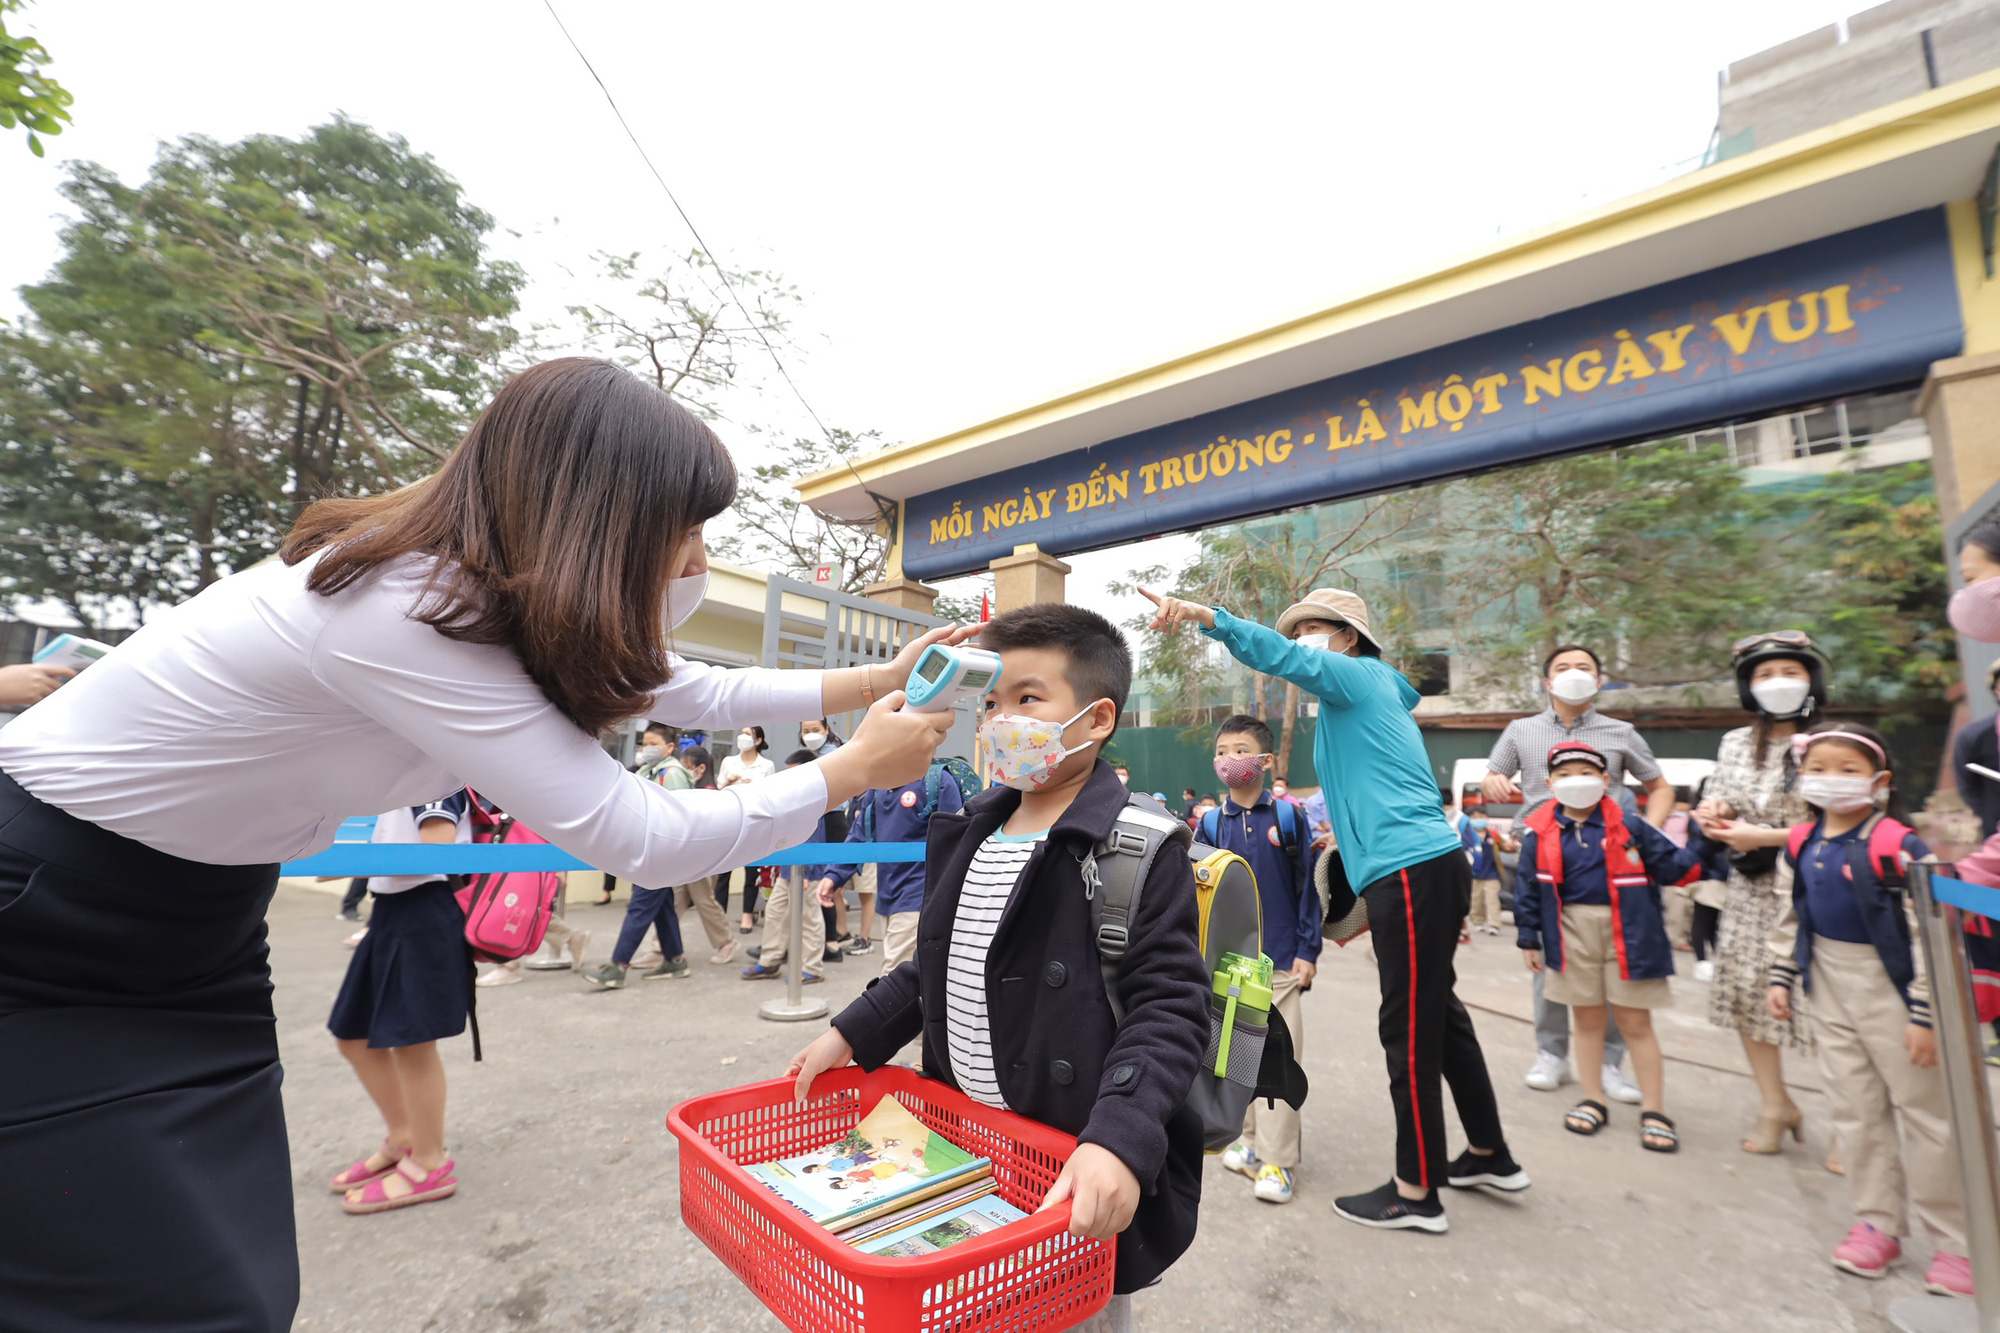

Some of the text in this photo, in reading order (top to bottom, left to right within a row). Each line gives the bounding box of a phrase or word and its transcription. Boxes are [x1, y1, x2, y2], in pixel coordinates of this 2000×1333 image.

[929, 500, 973, 545] MỖI
[982, 487, 1057, 532] NGÀY
[1066, 462, 1130, 513] ĐẾN
[1139, 434, 1294, 494] TRƯỜNG
[1326, 398, 1388, 451] LÀ
[1398, 373, 1508, 432] MỘT
[1520, 324, 1695, 405] NGÀY
[1711, 284, 1855, 355] VUI
